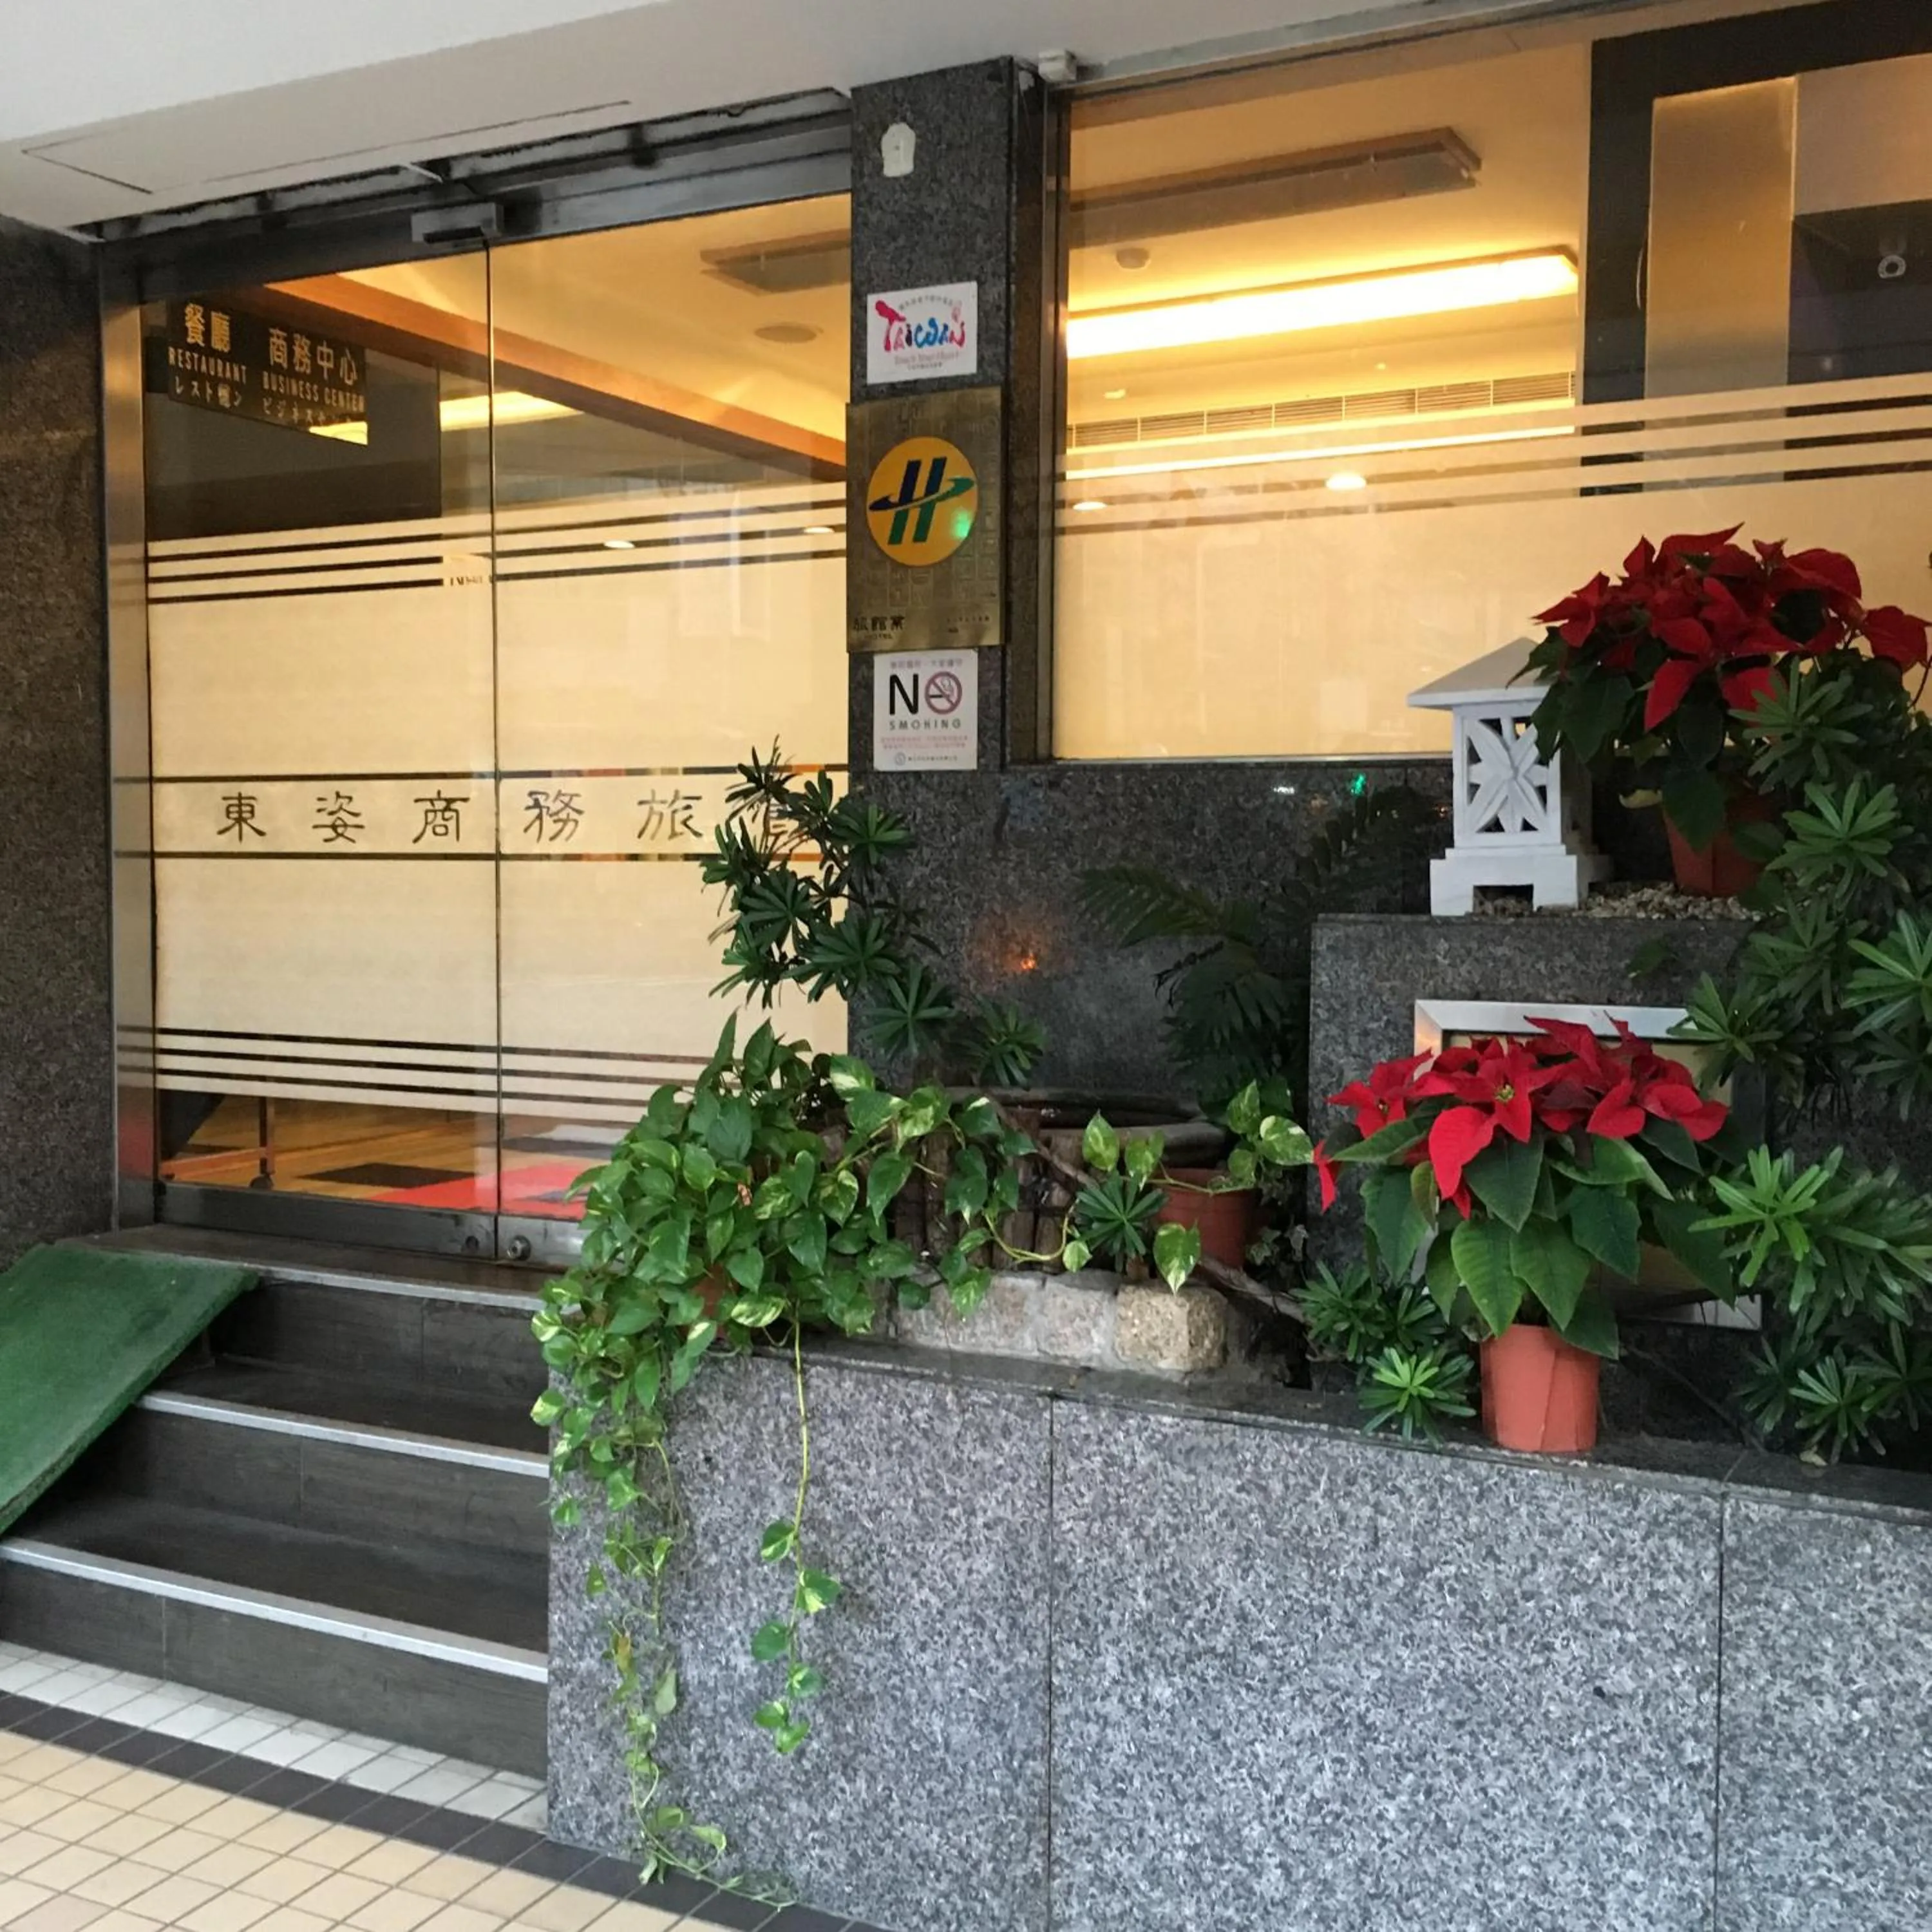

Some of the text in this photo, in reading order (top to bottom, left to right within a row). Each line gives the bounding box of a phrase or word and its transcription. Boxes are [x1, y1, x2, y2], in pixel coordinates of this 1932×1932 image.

[168, 346, 247, 384] RESTAURANT
[269, 327, 358, 386] 商務中心
[262, 370, 365, 412] BUSINESS CENTER
[889, 719, 961, 730] SMOKING
